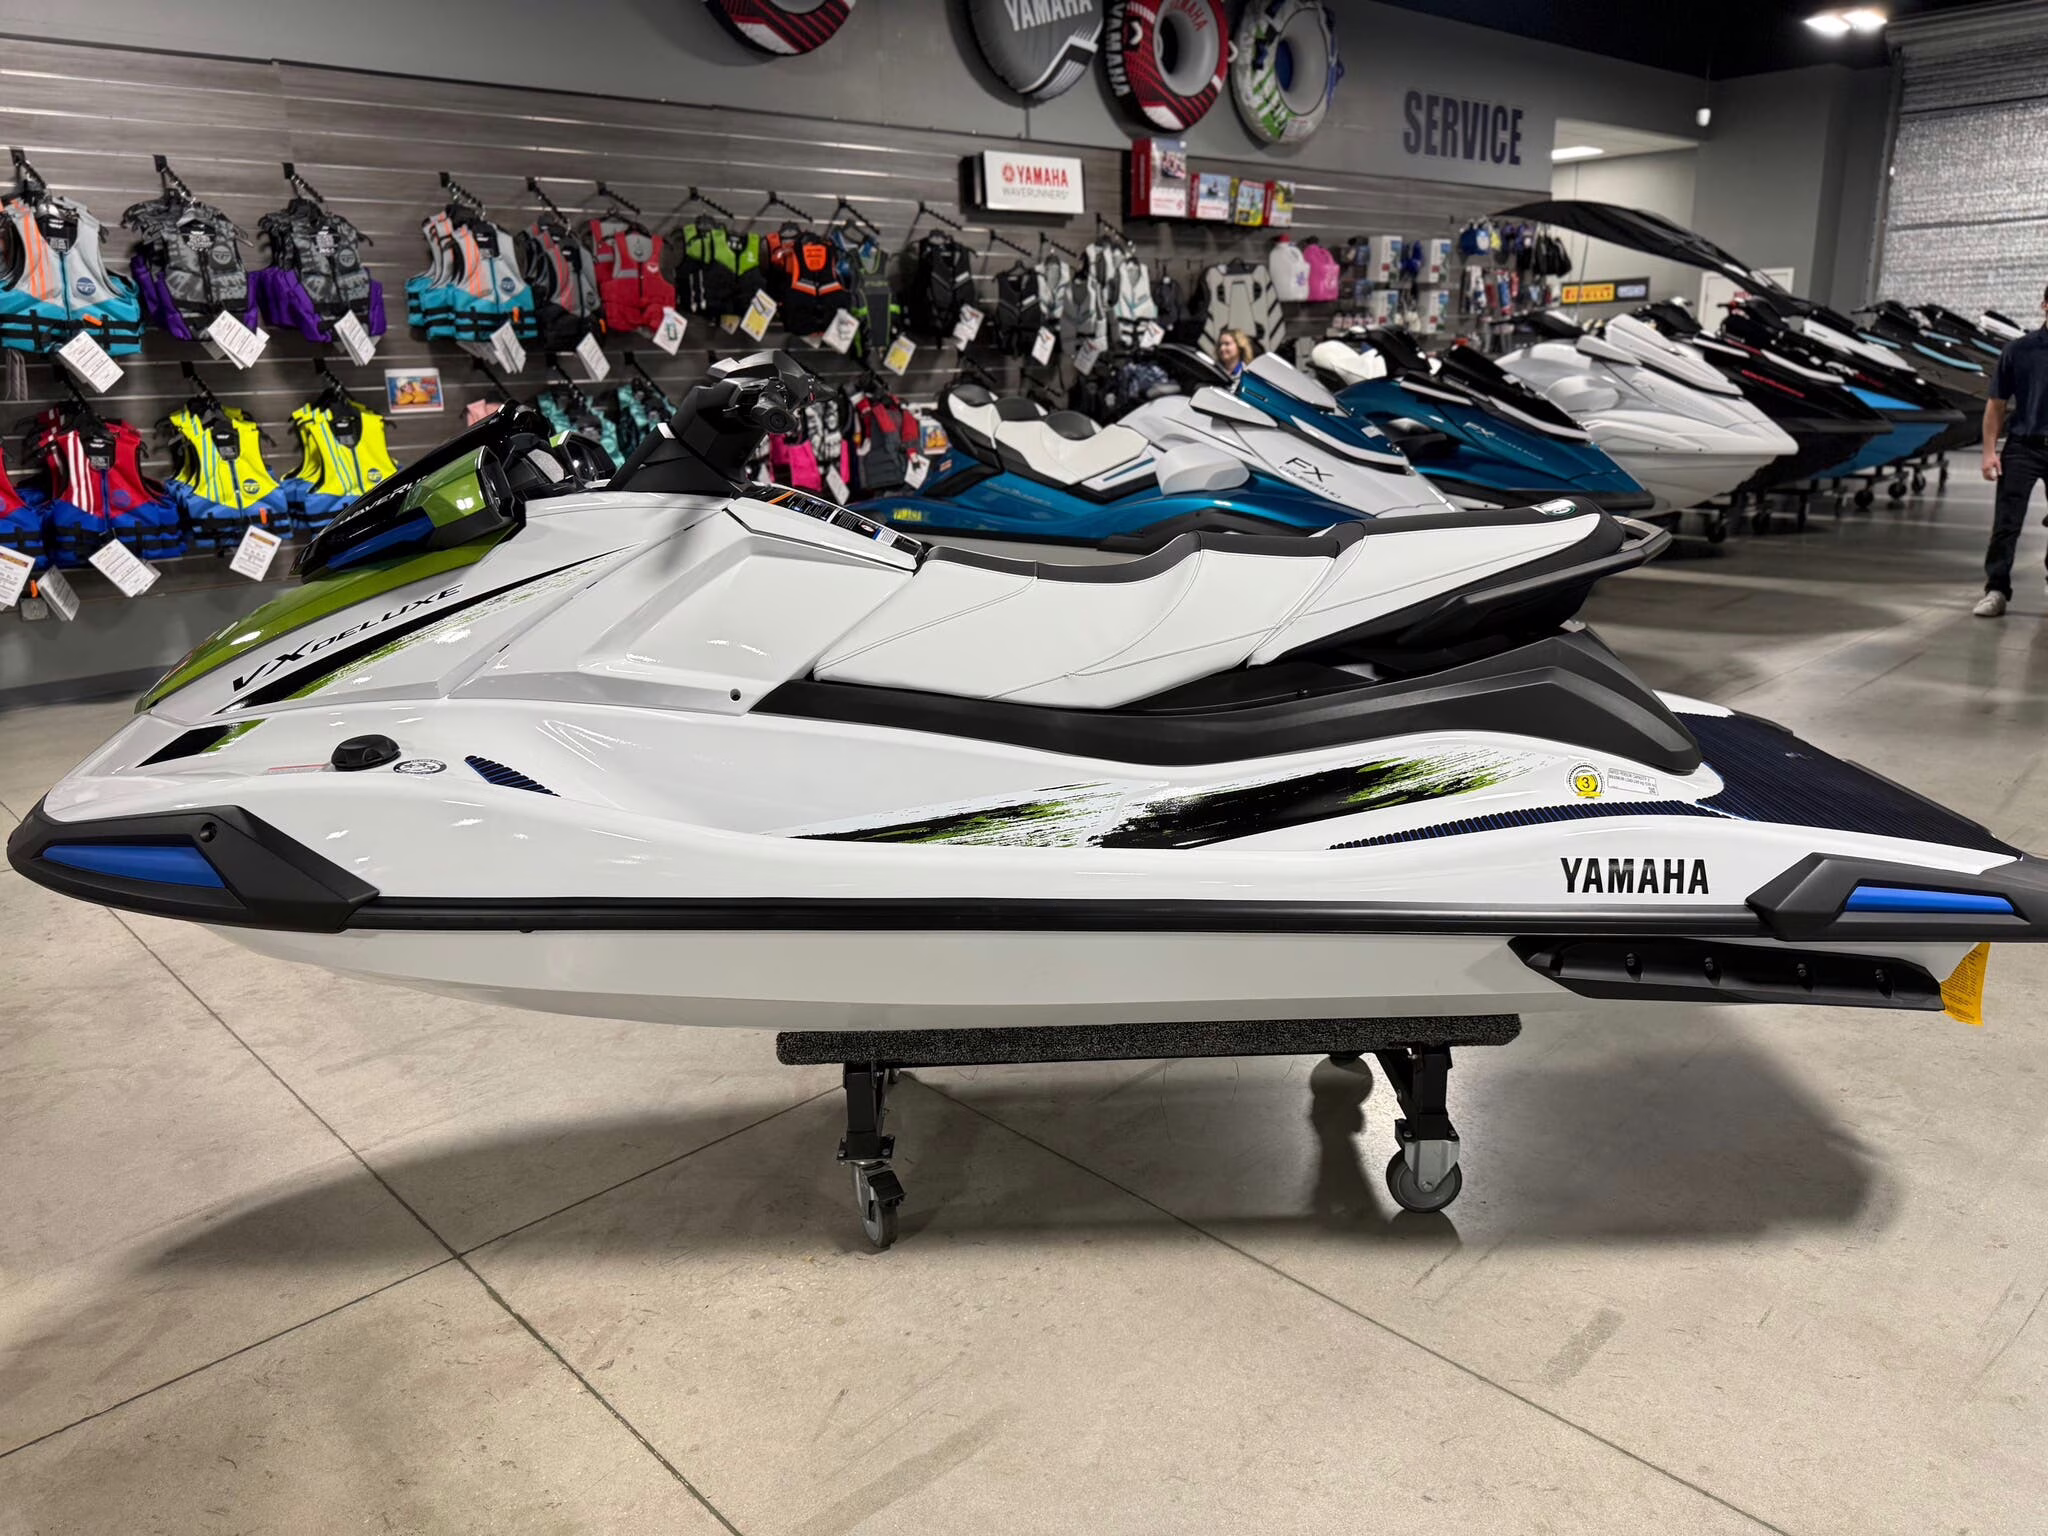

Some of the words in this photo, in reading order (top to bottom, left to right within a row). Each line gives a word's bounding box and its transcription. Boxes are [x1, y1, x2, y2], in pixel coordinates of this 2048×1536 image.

[1403, 90, 1523, 165] SERVICE
[1016, 165, 1069, 188] YAMAHA
[1285, 457, 1334, 482] FX
[232, 639, 315, 692] VX
[311, 584, 463, 653] DELUXE
[1582, 776, 1590, 789] 3
[1560, 857, 1709, 894] YAMAHA
